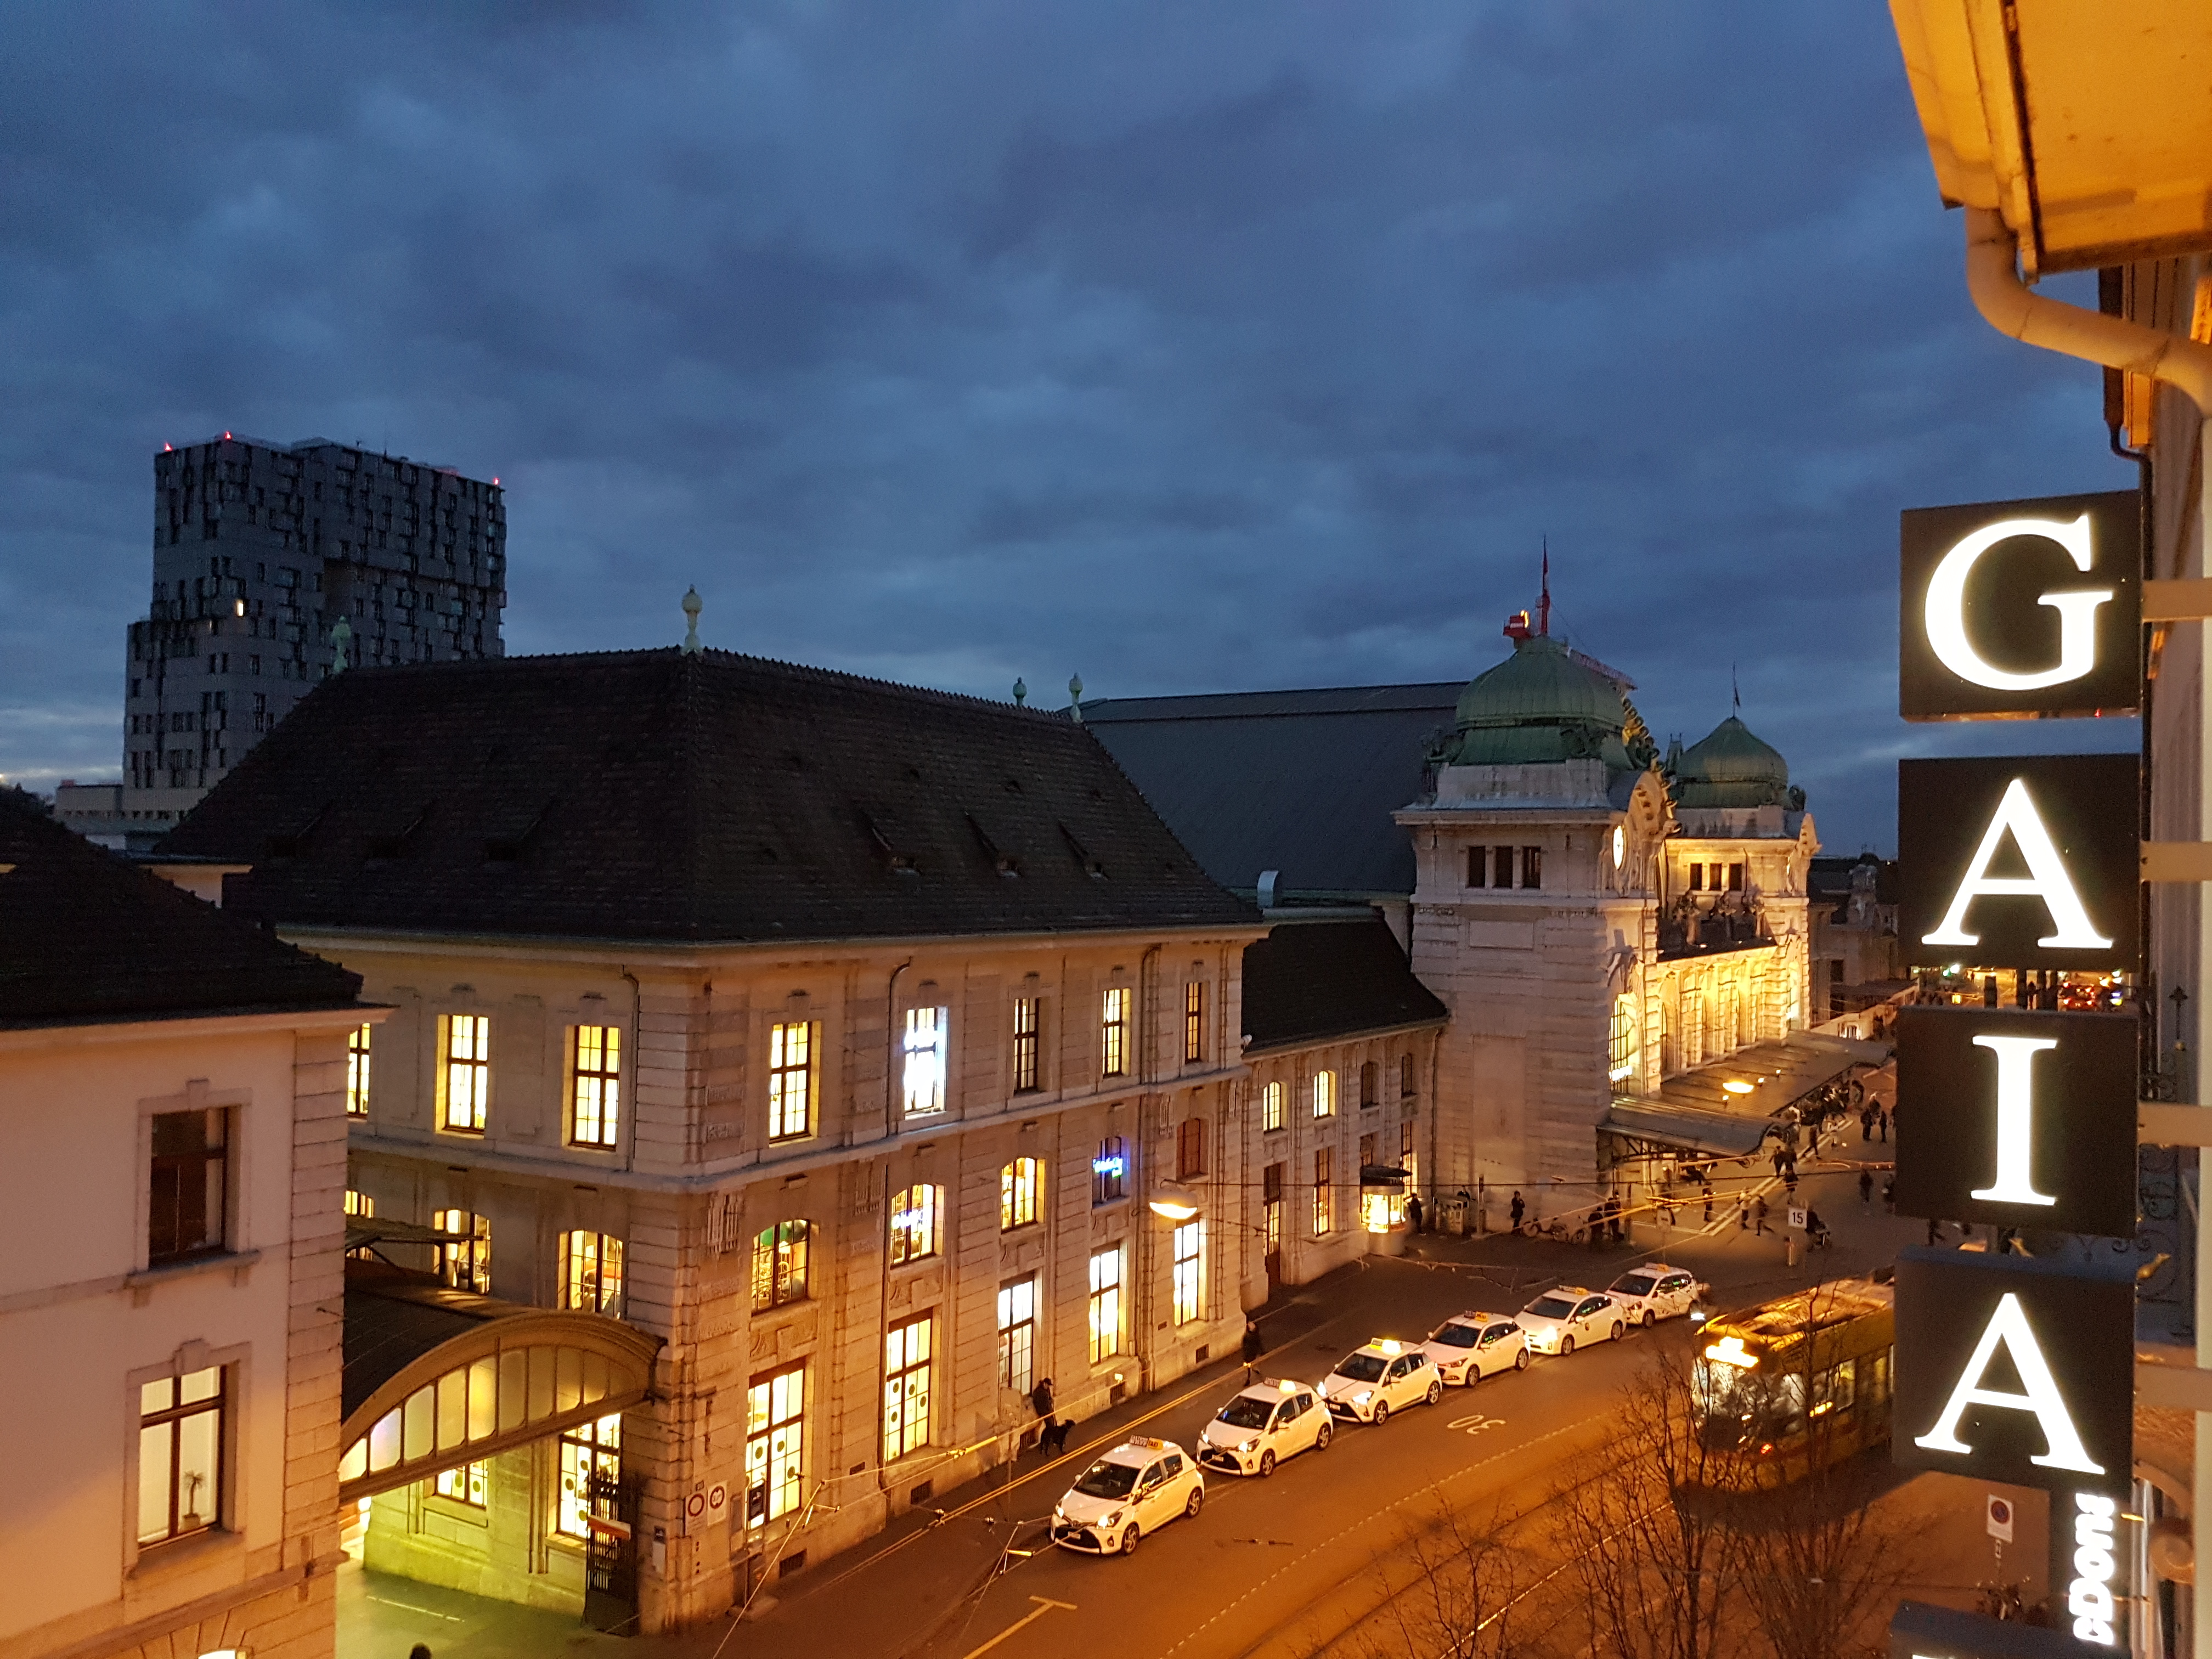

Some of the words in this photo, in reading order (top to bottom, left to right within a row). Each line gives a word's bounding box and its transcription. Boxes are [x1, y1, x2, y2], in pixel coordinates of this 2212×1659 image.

[1914, 514, 2113, 1475] GAIA
[1793, 1212, 1803, 1224] 15
[1447, 1415, 1505, 1434] 30
